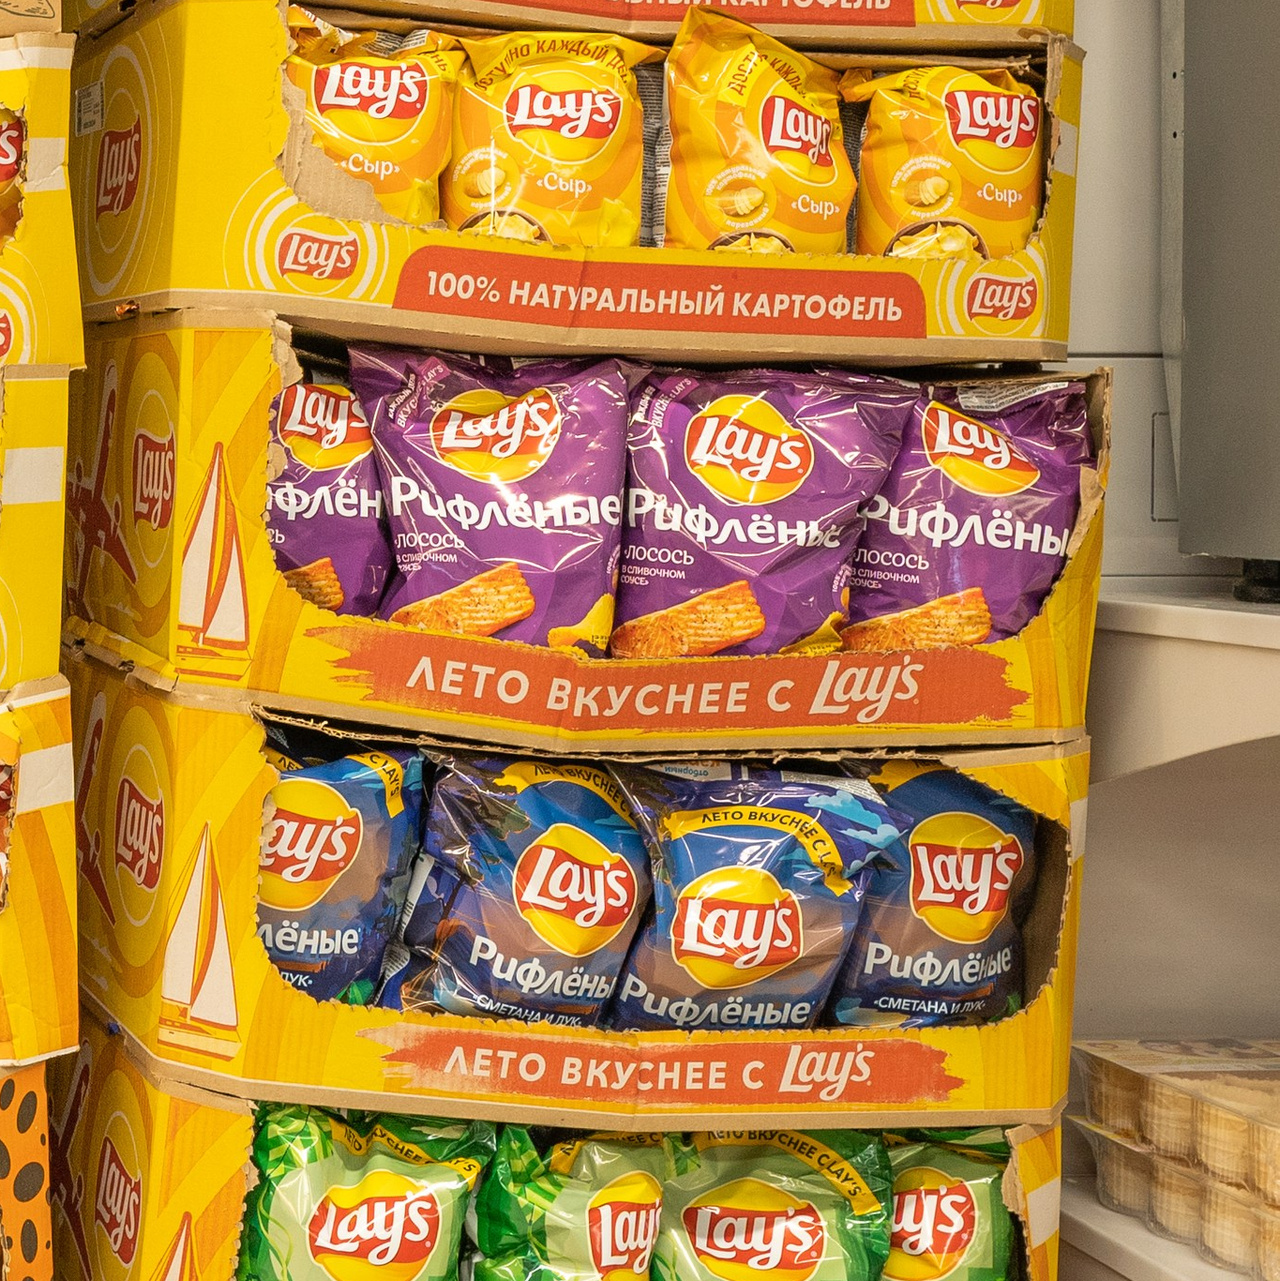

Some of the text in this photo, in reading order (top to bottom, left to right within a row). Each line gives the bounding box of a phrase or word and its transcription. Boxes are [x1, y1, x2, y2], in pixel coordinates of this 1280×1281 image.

[535, 39, 610, 63] КАЖДЫЙ
[340, 153, 401, 178] «Сыр»
[536, 172, 593, 196] «Сыр»
[976, 182, 1023, 205] «Сыр»
[791, 194, 840, 220] «Сыр»
[427, 270, 904, 322] 100% НАТУРАЛЬНЫЙ КАРТОФЕЛЬ
[623, 545, 695, 565] «ЛОСОСЬ
[628, 567, 686, 580] СЛИВОЧНОМ
[858, 568, 920, 585] СЛИВОЧНОМ
[406, 656, 923, 723] ЛЕТО ВКУСНЕЕ С Lay's
[701, 810, 744, 824] ЛЕТО
[748, 810, 818, 842] ВКУСНЕЕ
[873, 995, 948, 1015] «СМЕТАНА
[959, 1001, 986, 1013] ЛУК»
[443, 1042, 871, 1100] ЛЕТО ВКУСНЕЕ С Lay's
